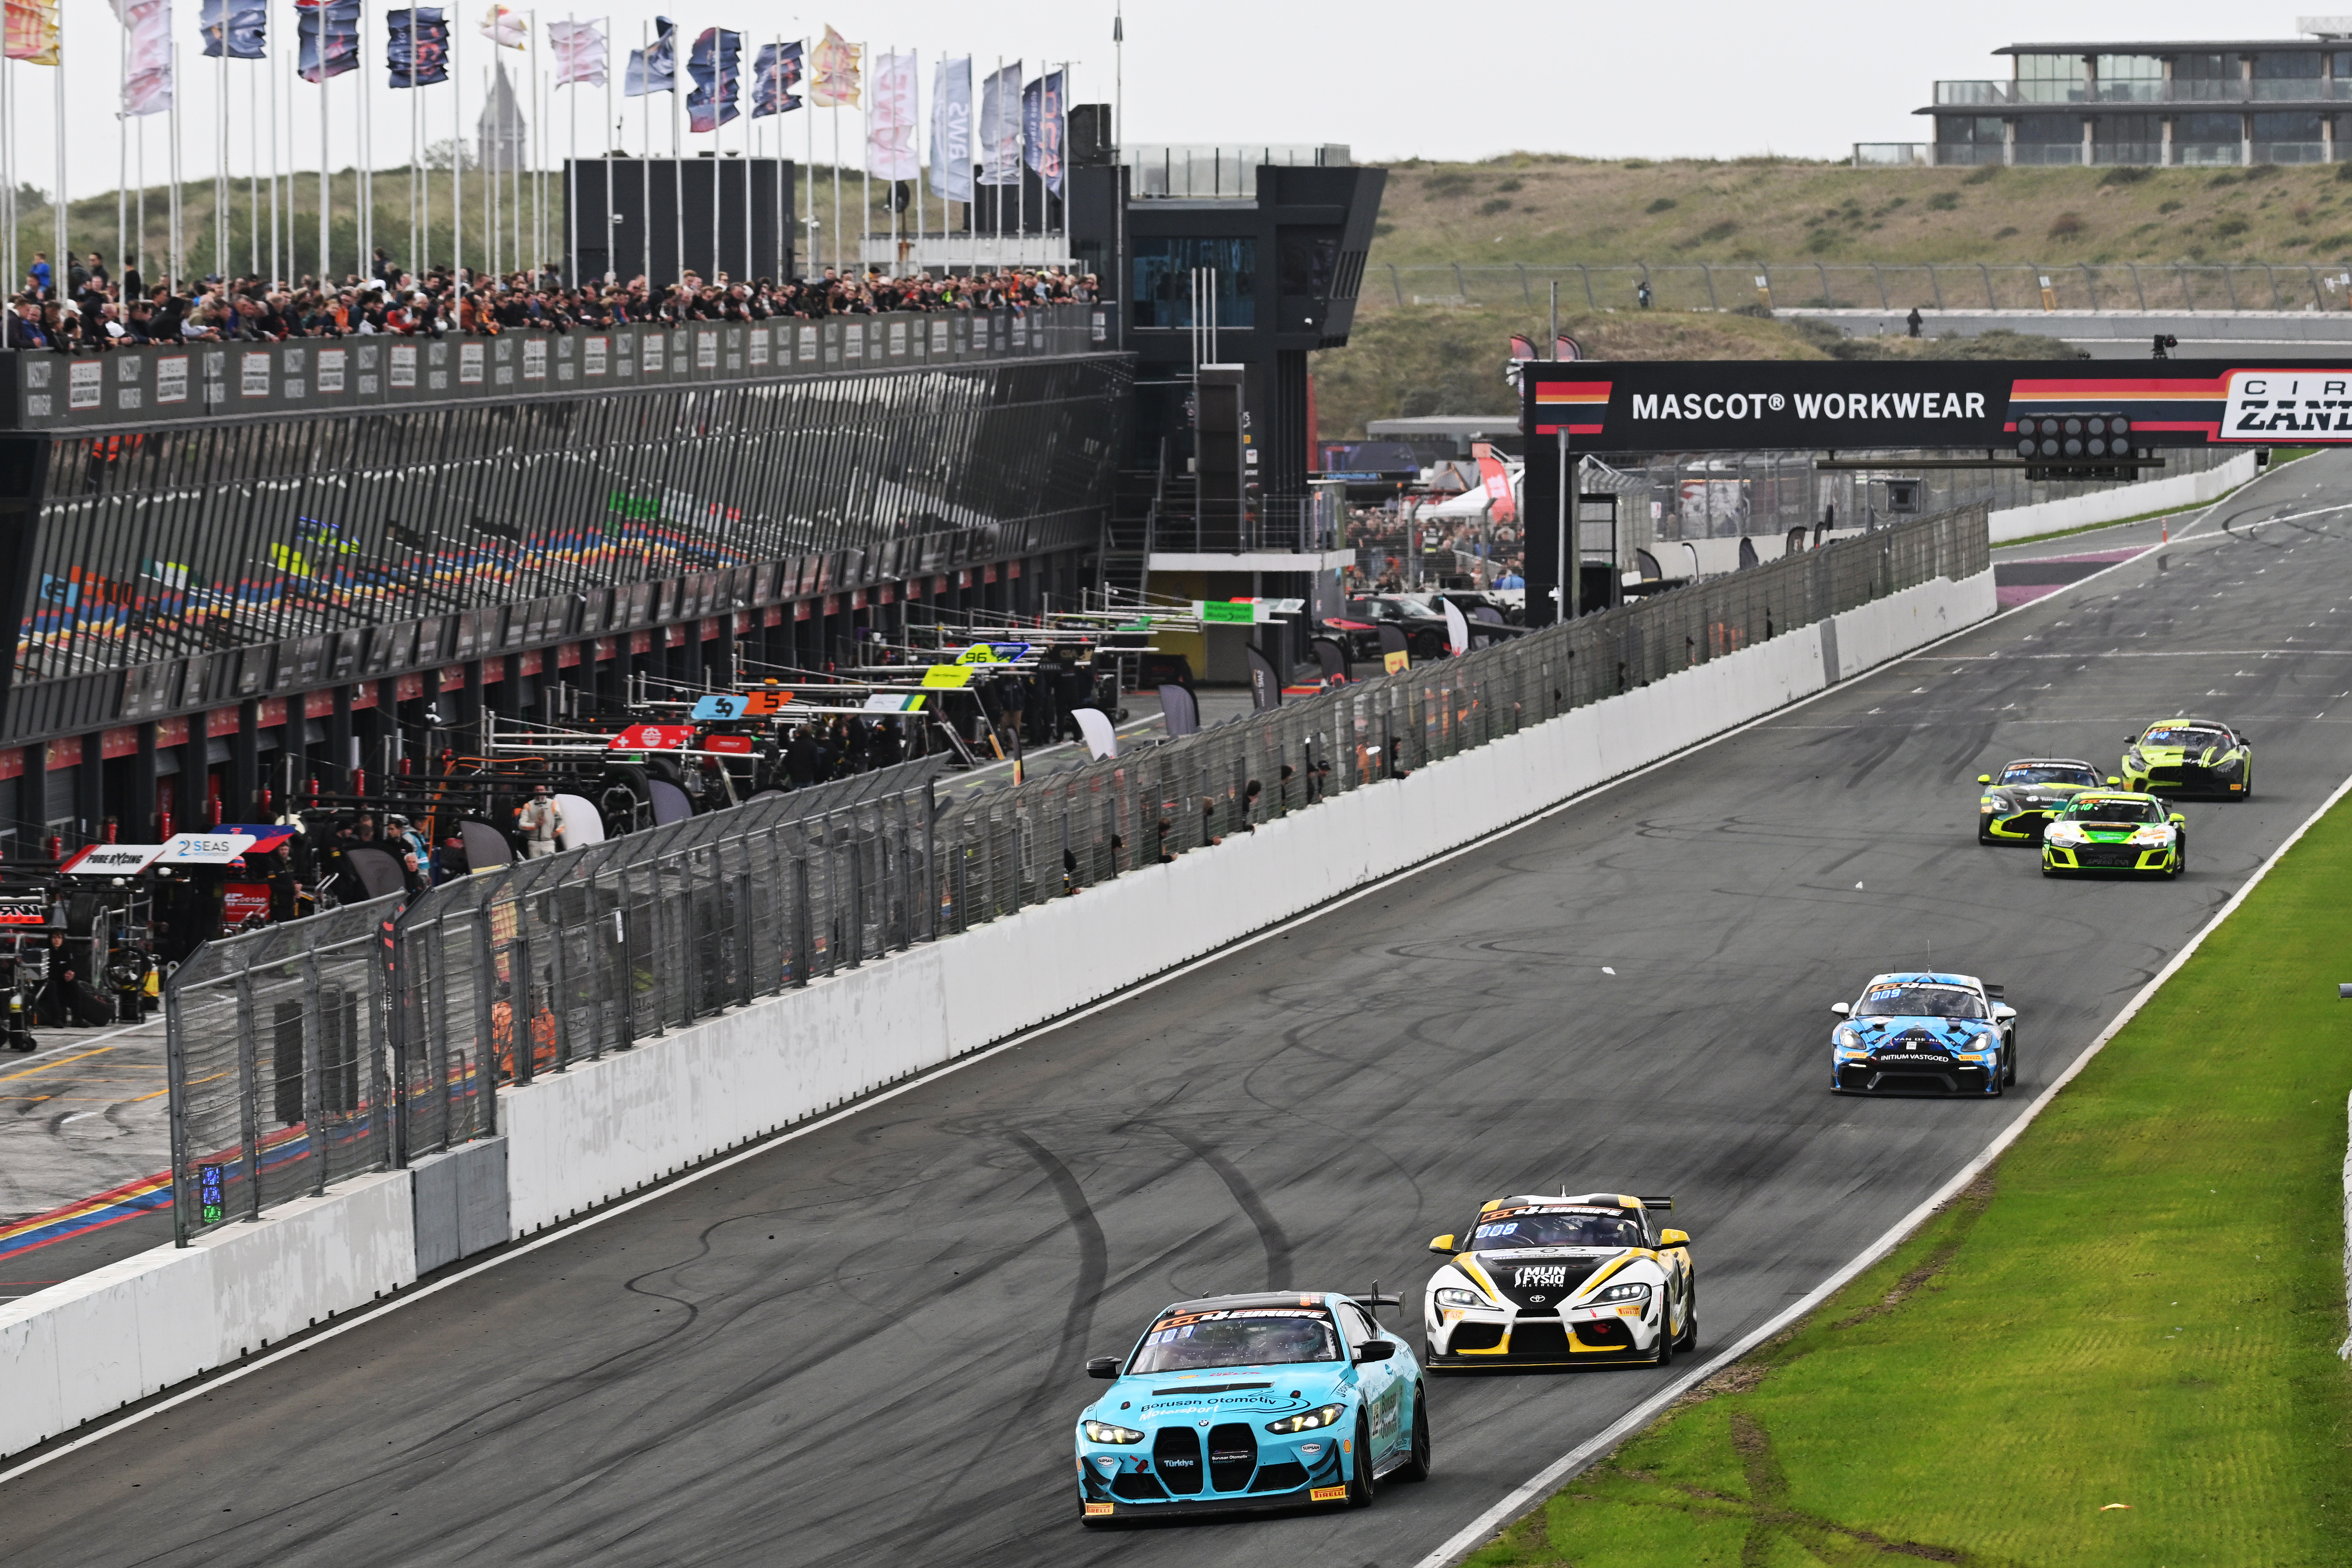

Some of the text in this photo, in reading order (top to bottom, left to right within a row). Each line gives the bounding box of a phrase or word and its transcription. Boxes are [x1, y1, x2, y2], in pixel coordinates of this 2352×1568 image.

[1794, 392, 1985, 419] WORKWEAR
[965, 653, 987, 663] 96
[764, 692, 779, 708] 5
[715, 698, 733, 717] 59
[194, 841, 229, 851] SEAS
[1870, 988, 1901, 1001] 009
[1910, 1054, 1949, 1062] VASTGOED
[1475, 1223, 1519, 1239] 008
[1619, 1307, 1639, 1316] PIRELLI
[1141, 1396, 1277, 1412] Borusan Otomotiv
[1138, 1404, 1220, 1421] Motorsport
[1372, 1413, 1379, 1437] 12
[1164, 1459, 1194, 1468] Türkiye
[1314, 1486, 1346, 1499] PIRELLI
[1085, 1504, 1111, 1514] PIRELLI
